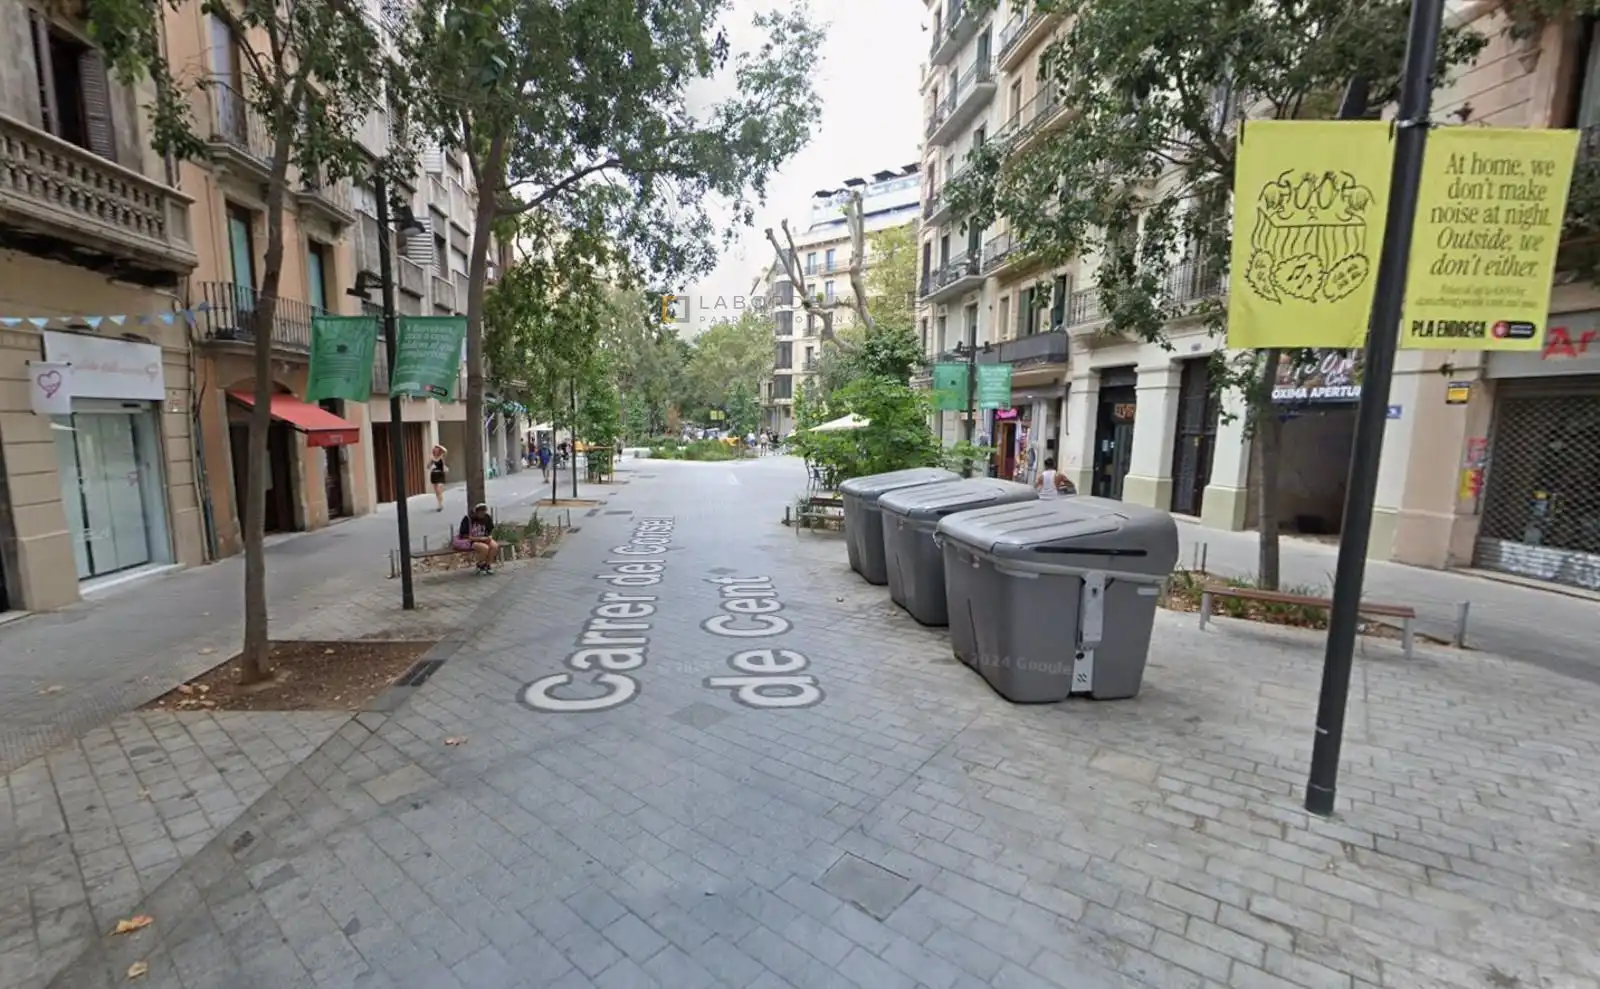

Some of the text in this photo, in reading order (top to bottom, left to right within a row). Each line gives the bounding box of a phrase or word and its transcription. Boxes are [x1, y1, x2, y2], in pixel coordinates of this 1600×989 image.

[1444, 152, 1464, 175] At
[1531, 160, 1556, 177] we
[1448, 177, 1547, 202] don't make
[1430, 201, 1479, 224] noise
[1483, 206, 1500, 224] at
[1437, 226, 1545, 253] Outside, we
[1429, 252, 1538, 277] don't either.
[1411, 320, 1434, 338] PLA
[1542, 327, 1600, 360] Ar
[523, 593, 658, 712] Carrer
[596, 560, 667, 586] del
[703, 575, 822, 708] de Cent
